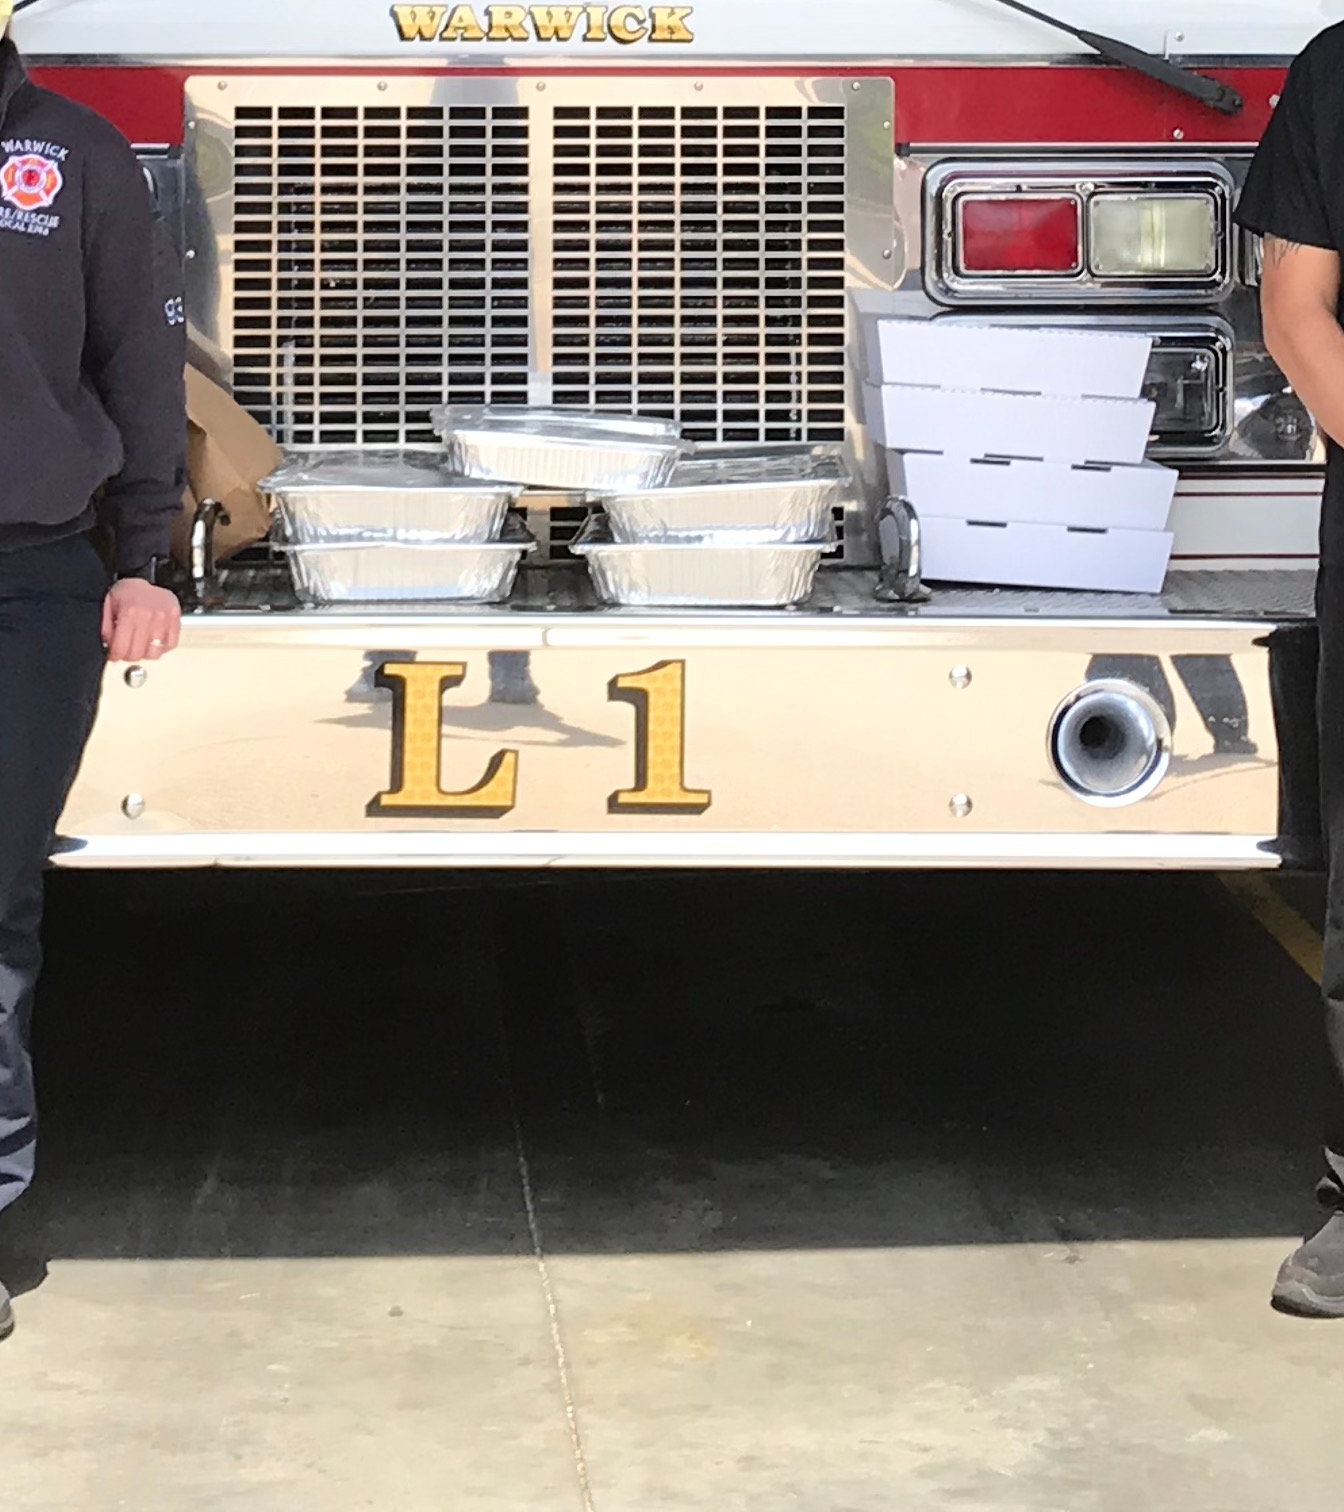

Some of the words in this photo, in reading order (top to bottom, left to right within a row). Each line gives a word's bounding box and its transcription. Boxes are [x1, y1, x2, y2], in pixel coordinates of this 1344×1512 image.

[390, 3, 694, 44] WARWICK
[1, 139, 69, 161] WARWICK
[365, 661, 520, 819] L
[607, 659, 712, 816] 1
